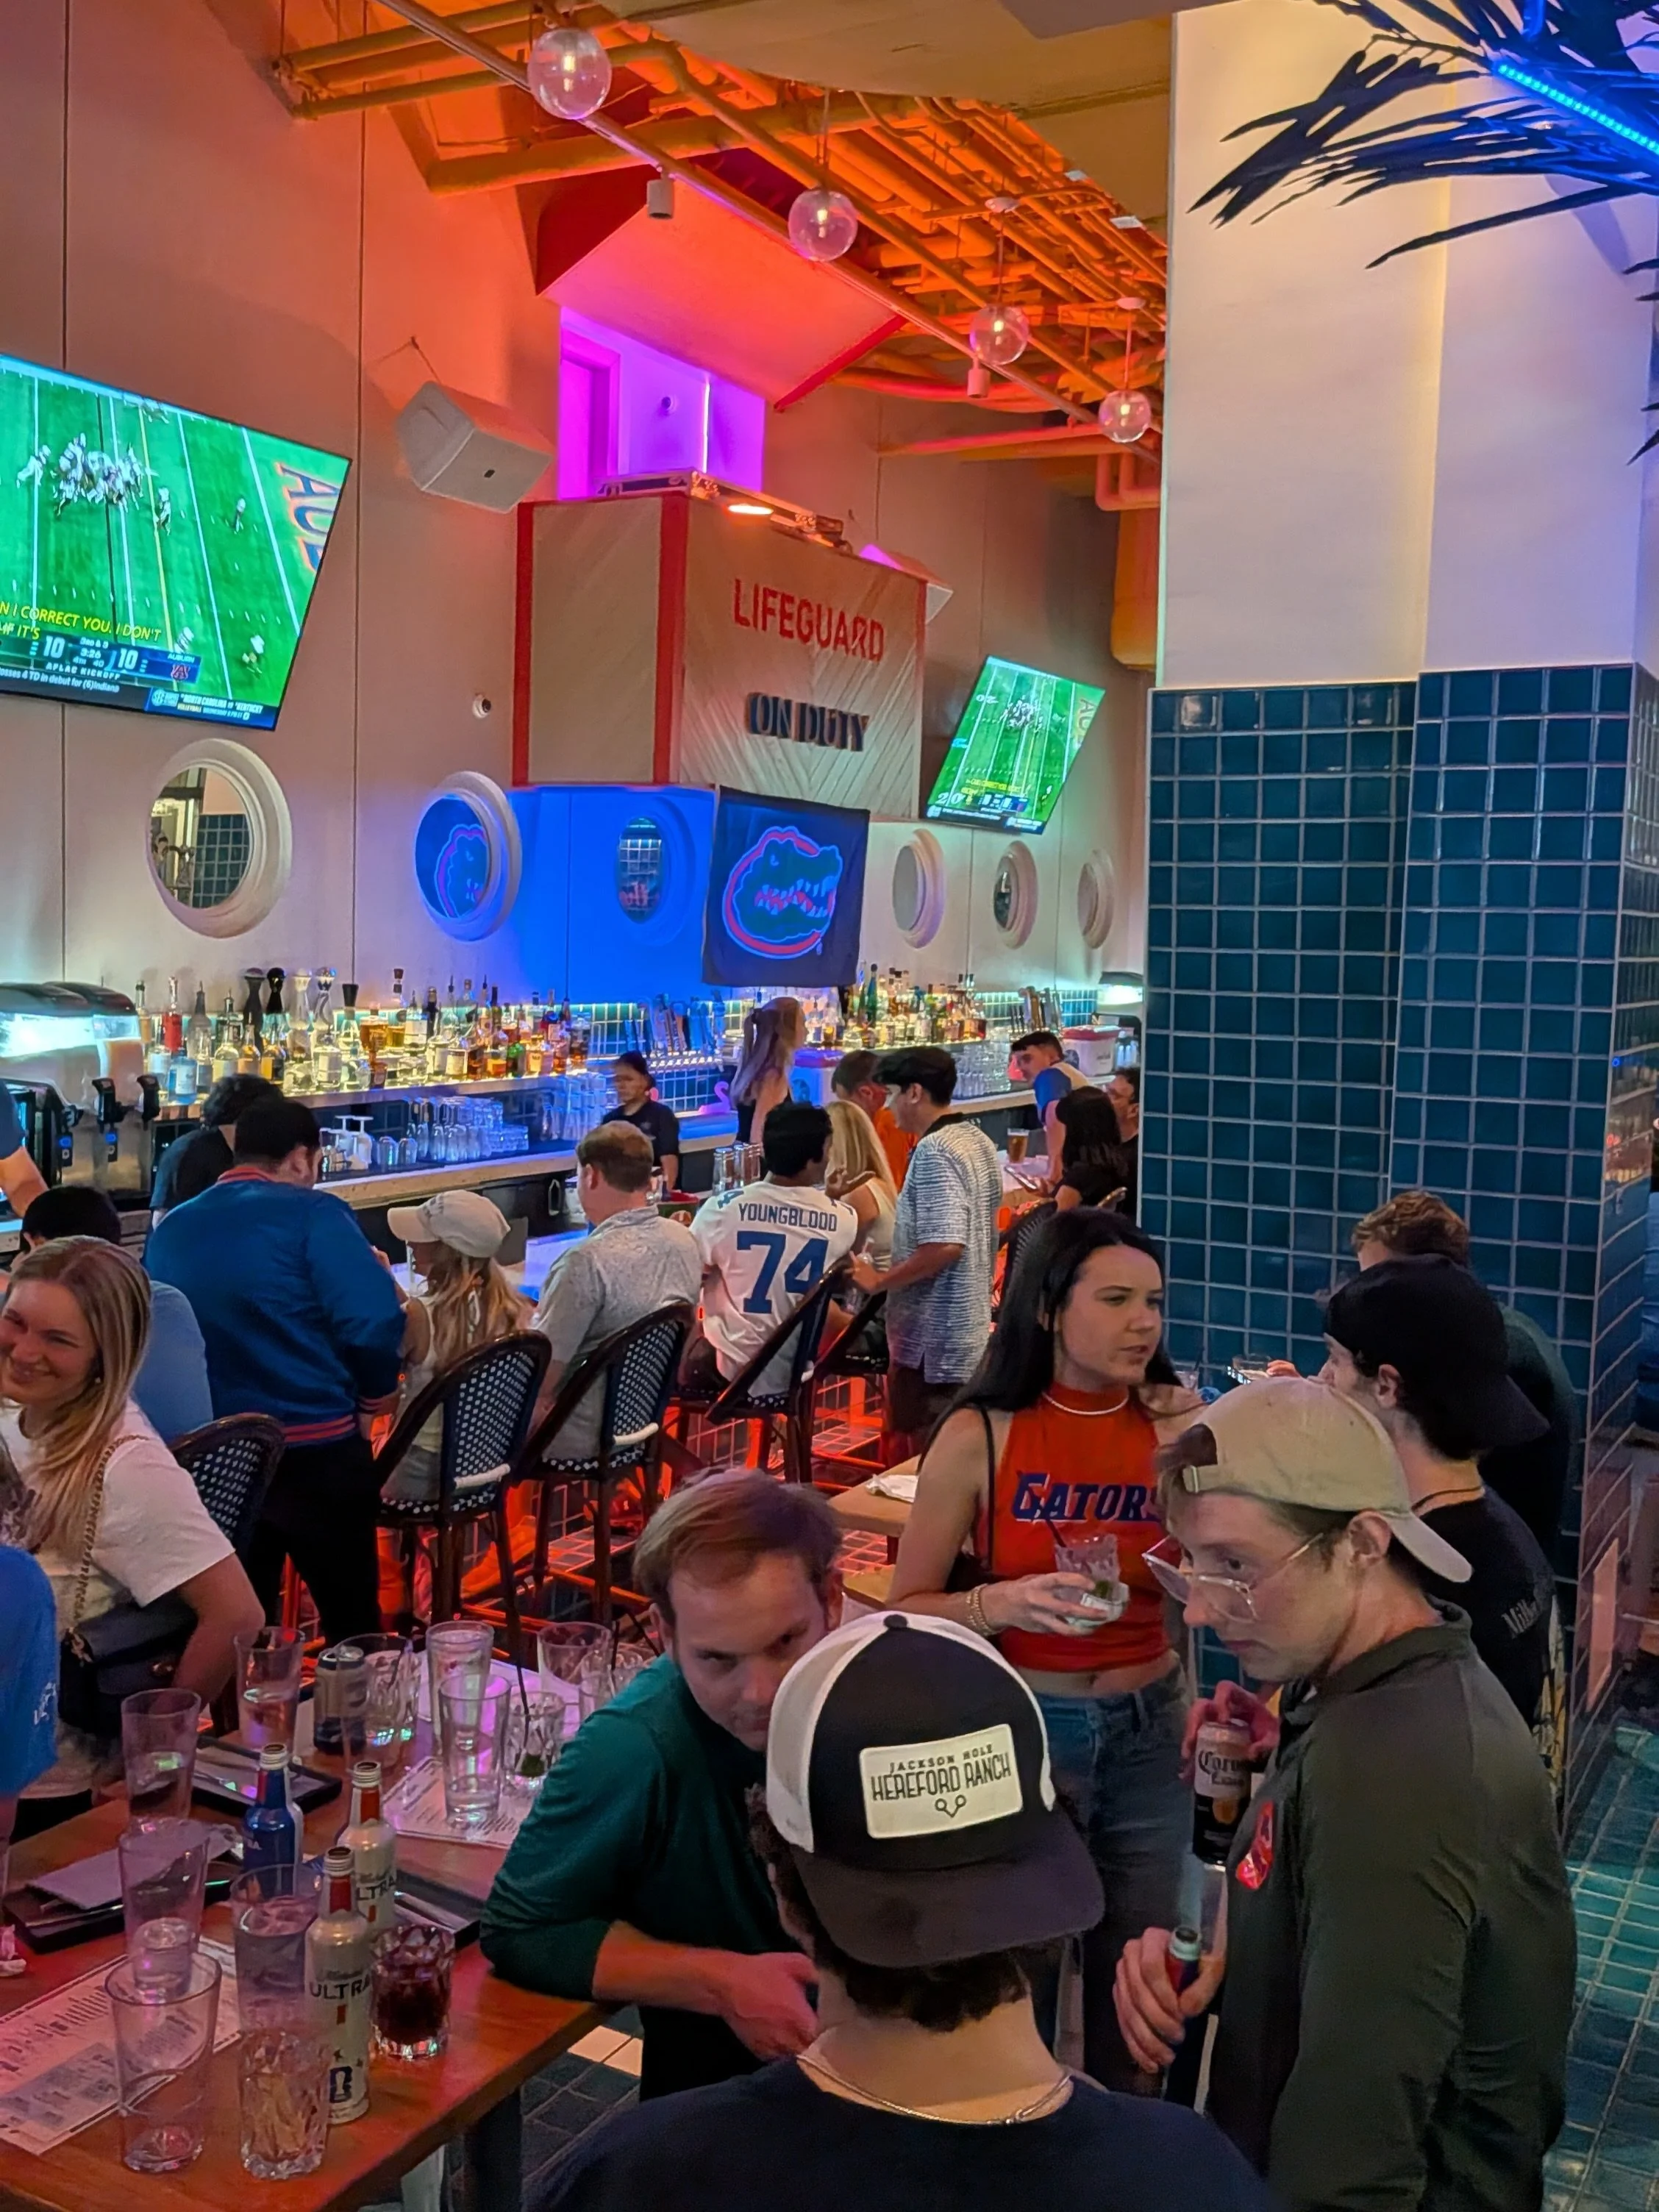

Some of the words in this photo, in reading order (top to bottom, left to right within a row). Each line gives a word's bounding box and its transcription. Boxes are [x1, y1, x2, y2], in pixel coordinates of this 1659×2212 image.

[17, 624, 40, 640] IT'S
[21, 605, 80, 628] CORRECT
[83, 616, 111, 634] YOU.
[123, 626, 161, 642] DON'T
[734, 578, 885, 663] LIFEGUARD
[43, 635, 65, 658] 10
[118, 647, 139, 670] 10
[168, 653, 195, 663] AUBURN
[46, 662, 77, 674] AFLAC
[80, 667, 121, 680] KICKOFF
[745, 692, 792, 738] ON
[792, 702, 870, 752] DUTY
[738, 1202, 837, 1232] YOUNGBLOOD
[737, 1230, 829, 1314] 74
[889, 1755, 955, 1774] JACKSON
[963, 1744, 993, 1760] HOLE
[871, 1766, 961, 1802] HEREFORD
[964, 1752, 1012, 1789] RANCH
[357, 1874, 397, 1901] LTRA
